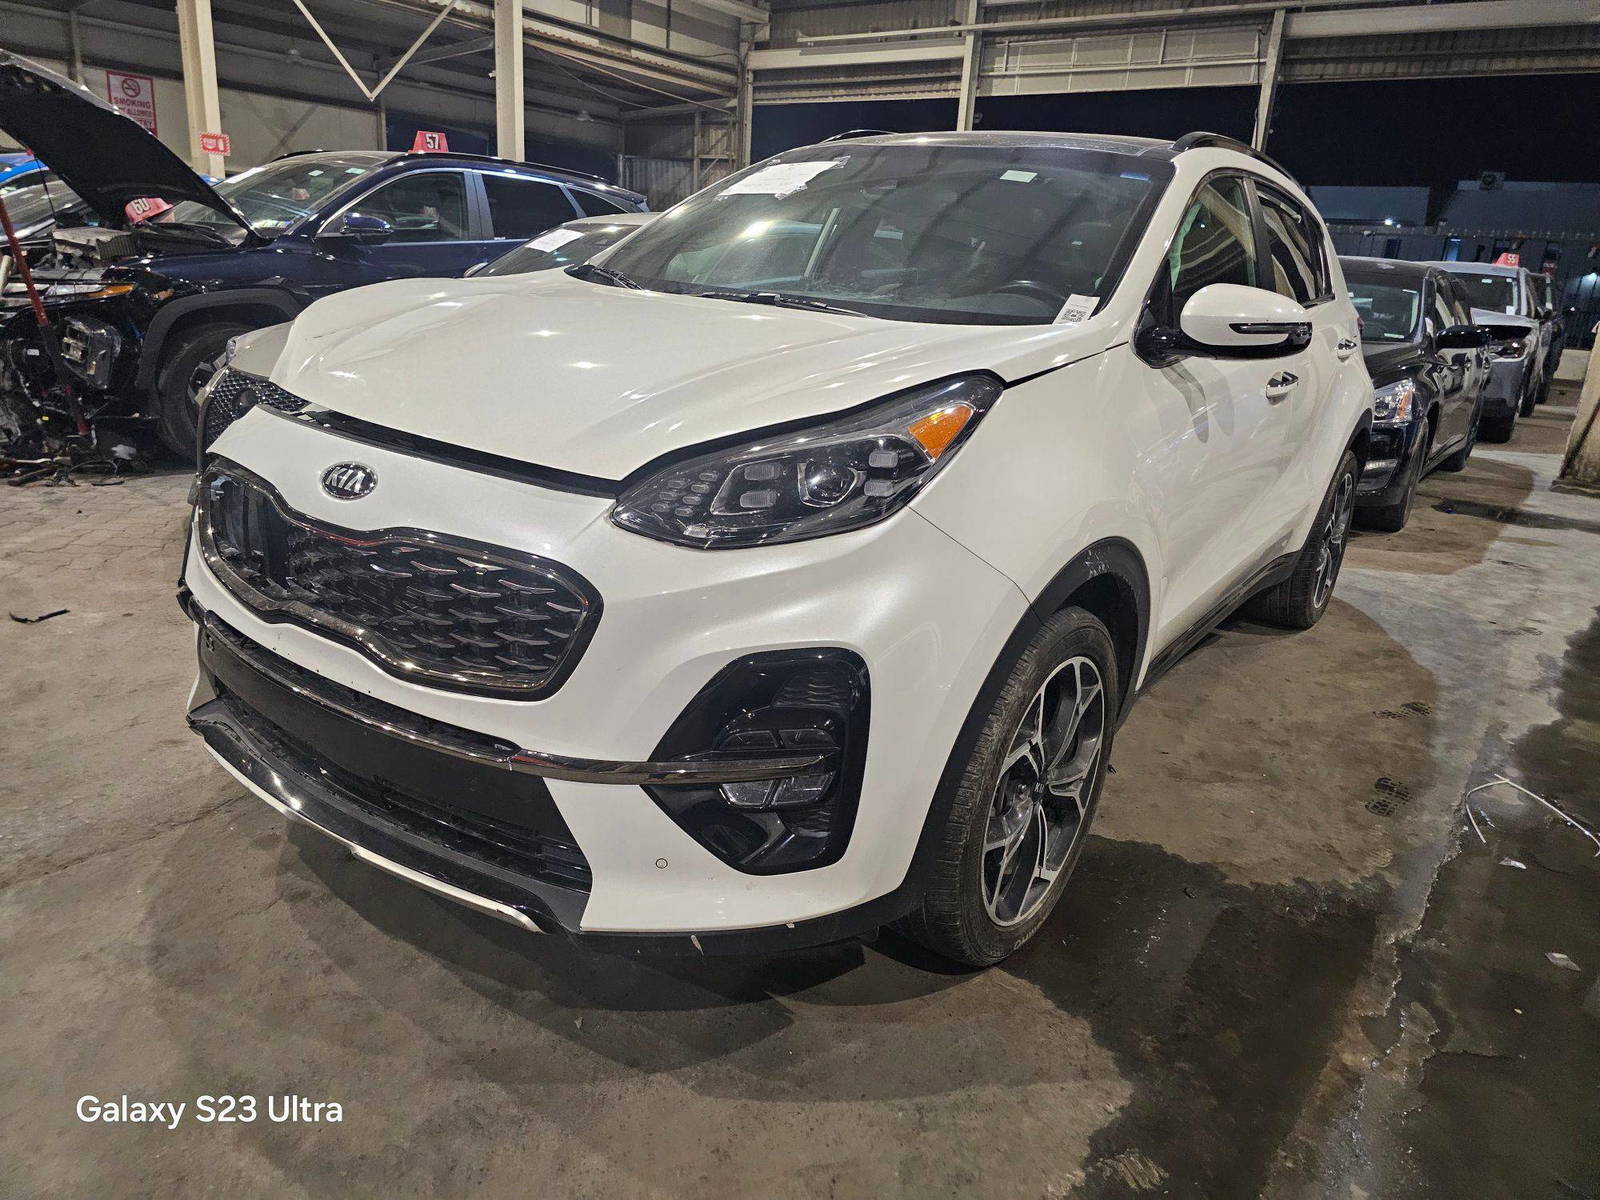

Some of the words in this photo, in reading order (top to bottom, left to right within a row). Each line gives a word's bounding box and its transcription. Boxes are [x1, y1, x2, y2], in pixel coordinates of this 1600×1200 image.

[113, 97, 151, 108] SMOKING
[426, 133, 439, 149] 57
[325, 466, 366, 493] KIA
